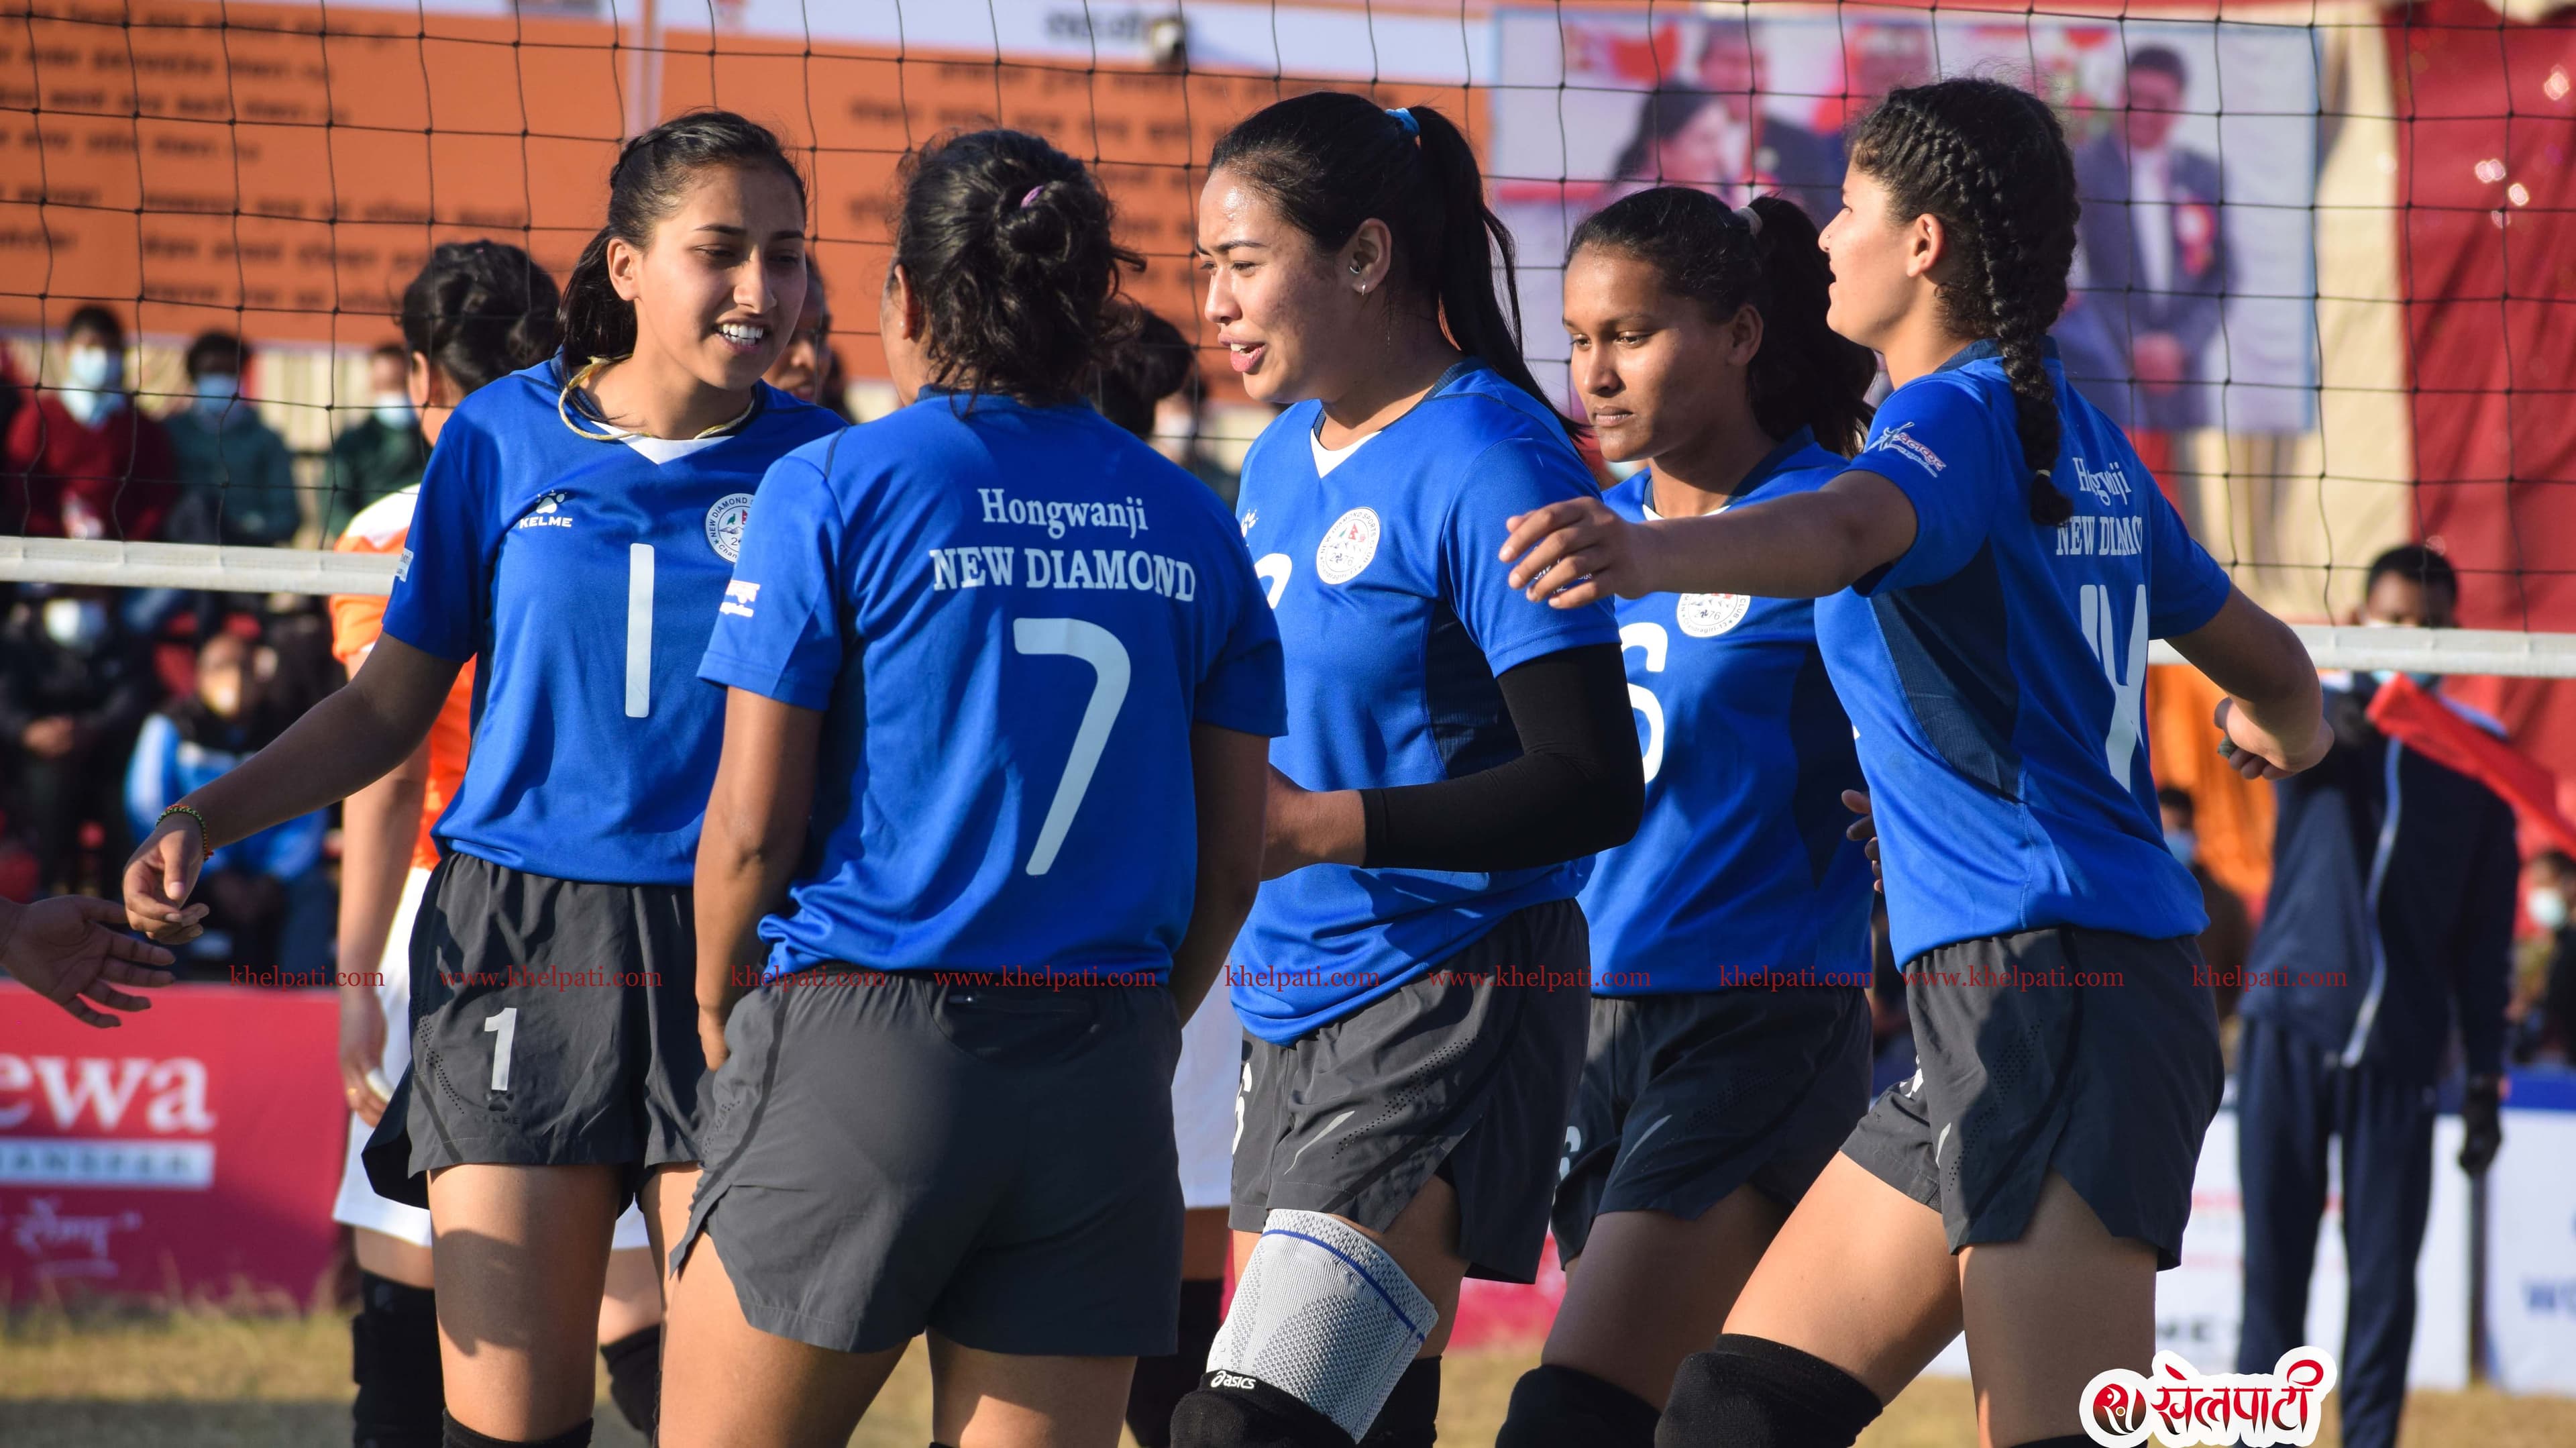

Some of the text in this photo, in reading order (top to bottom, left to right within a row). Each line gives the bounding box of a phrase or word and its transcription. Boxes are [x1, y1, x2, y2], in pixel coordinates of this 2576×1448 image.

[519, 516, 573, 529] KELME
[712, 497, 748, 518] DIAMOND
[977, 488, 1148, 539] Hongwanji
[2056, 516, 2096, 556] NEW
[929, 546, 1014, 591] NEW
[1024, 548, 1195, 602] DIAMOND
[625, 543, 655, 717] 1
[1013, 617, 1131, 876] 7
[484, 1007, 518, 1091] 1
[1222, 1374, 1256, 1390] asics
